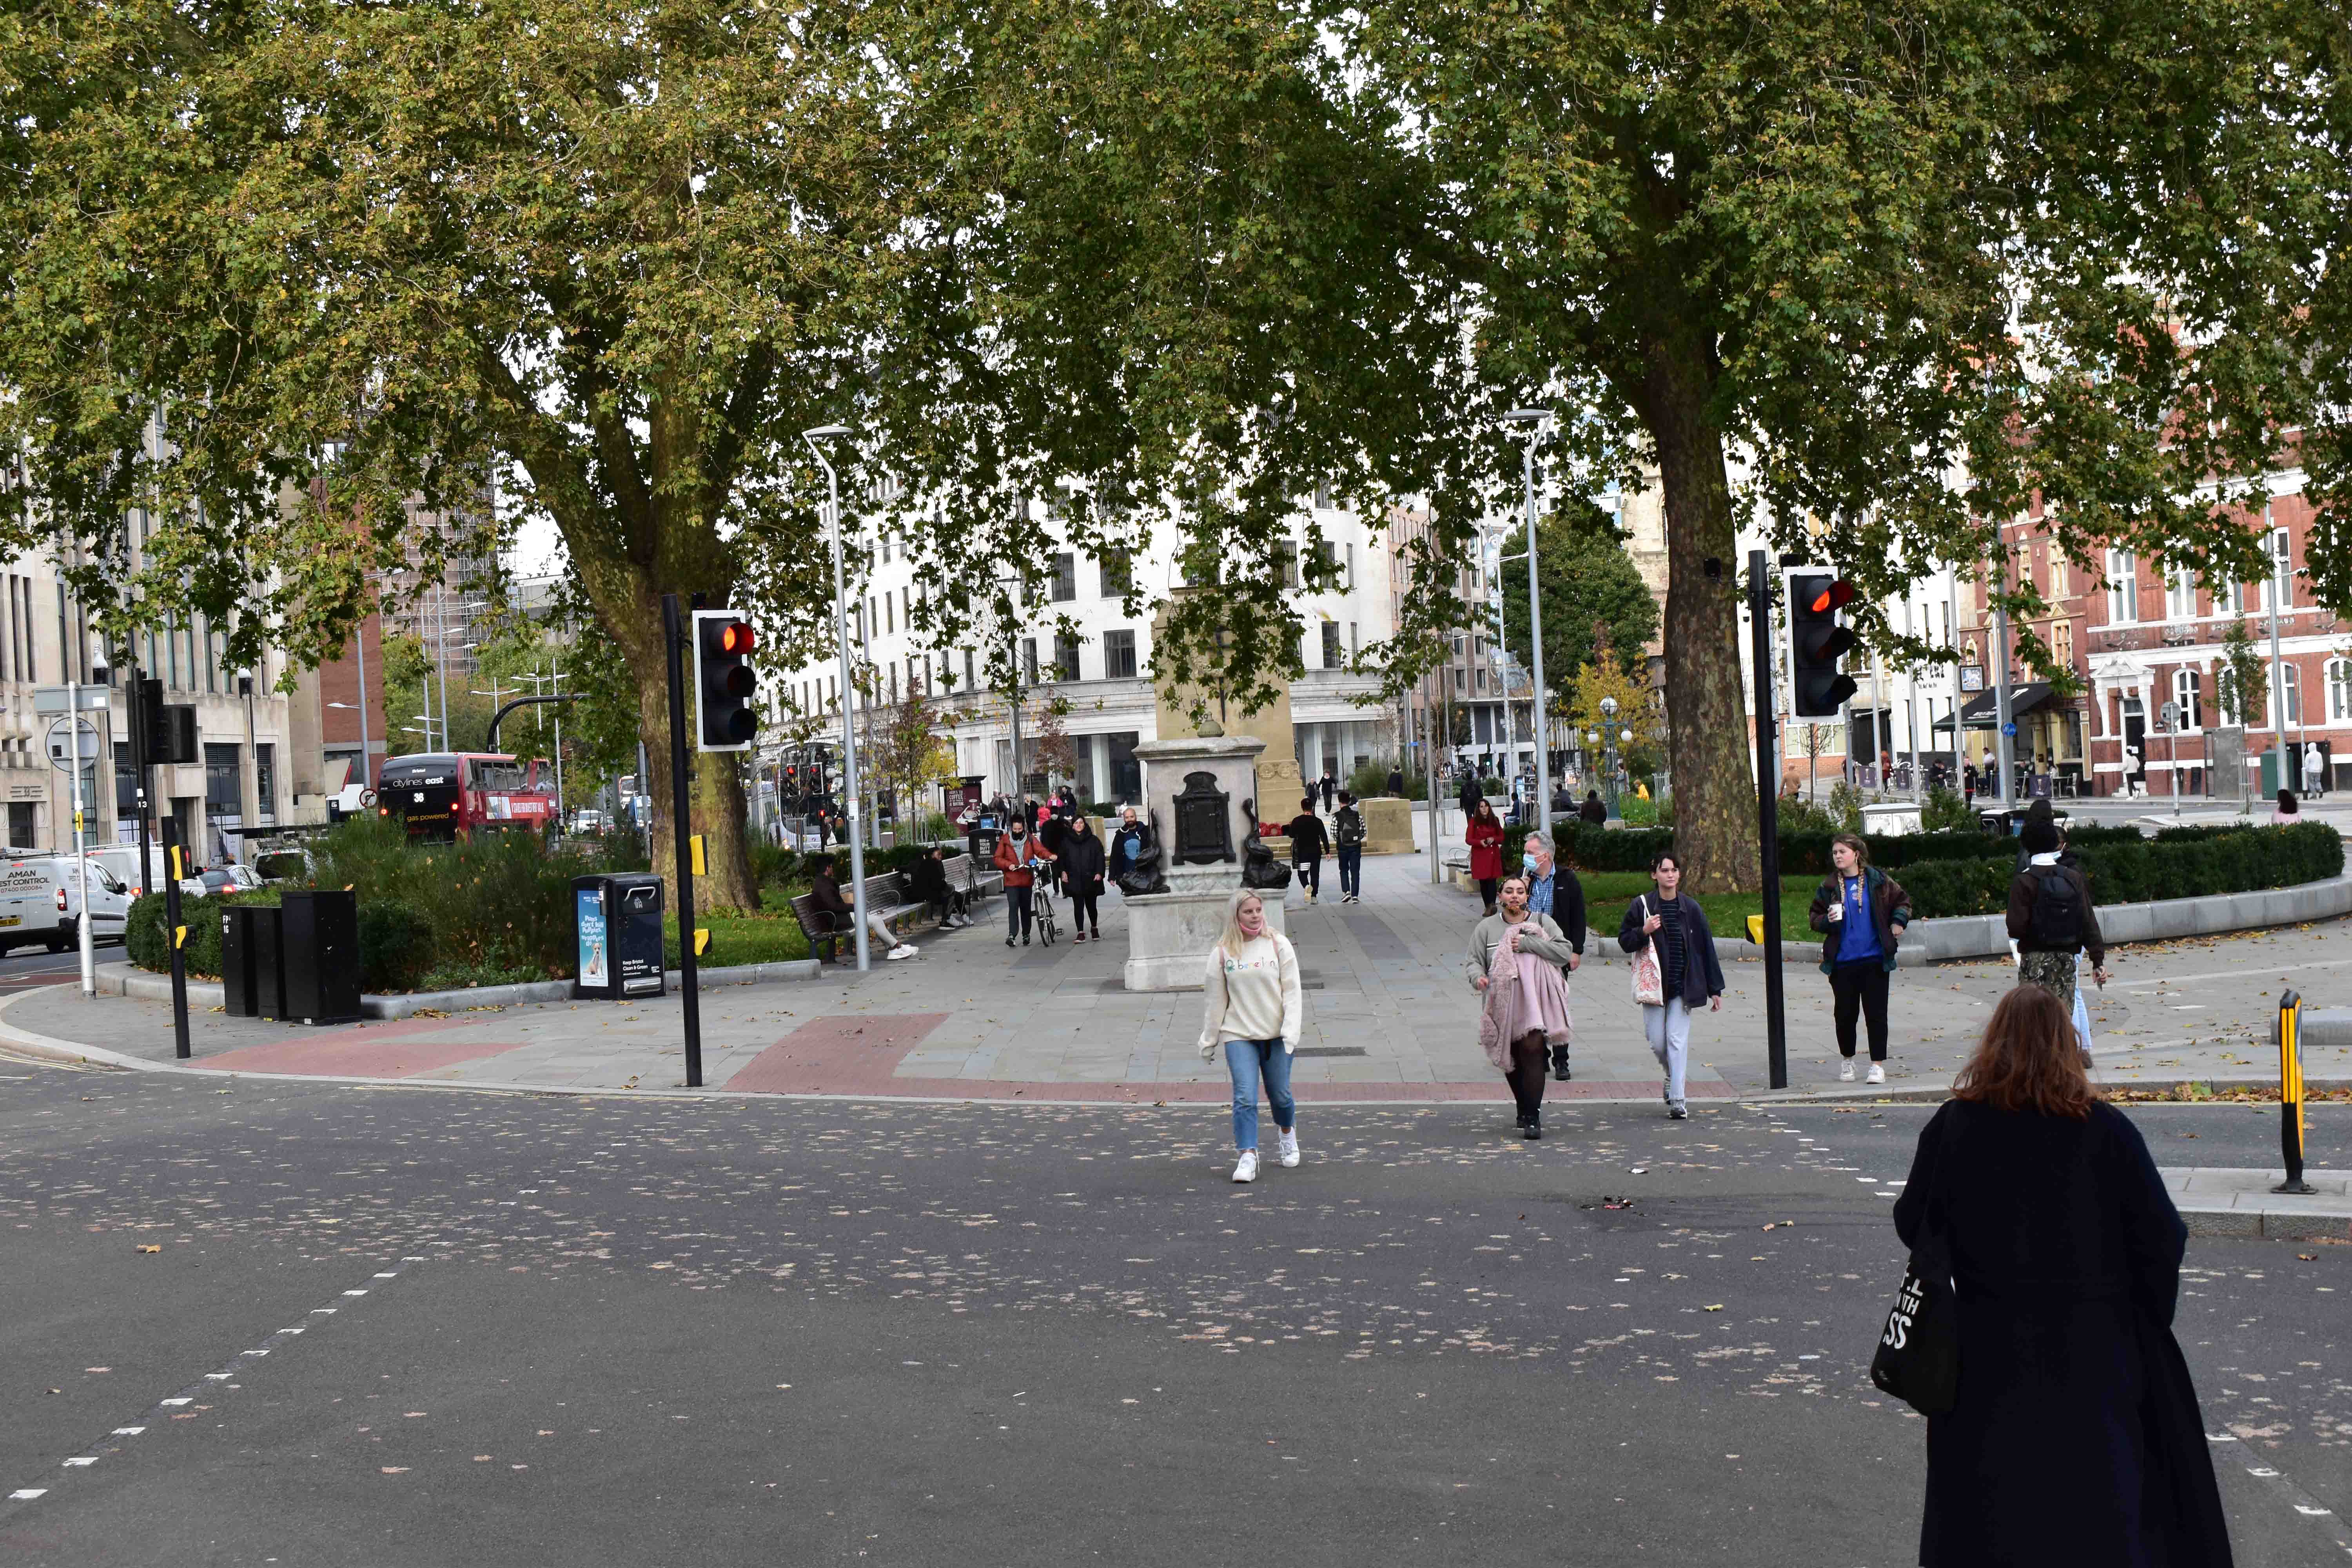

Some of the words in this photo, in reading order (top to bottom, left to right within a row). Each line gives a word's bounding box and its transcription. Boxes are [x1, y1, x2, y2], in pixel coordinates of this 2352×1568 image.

[393, 779, 423, 788] citylines
[414, 793, 424, 802] 36
[420, 813, 449, 821] powered
[7, 870, 36, 879] AMAN
[13, 877, 50, 886] CONTROL
